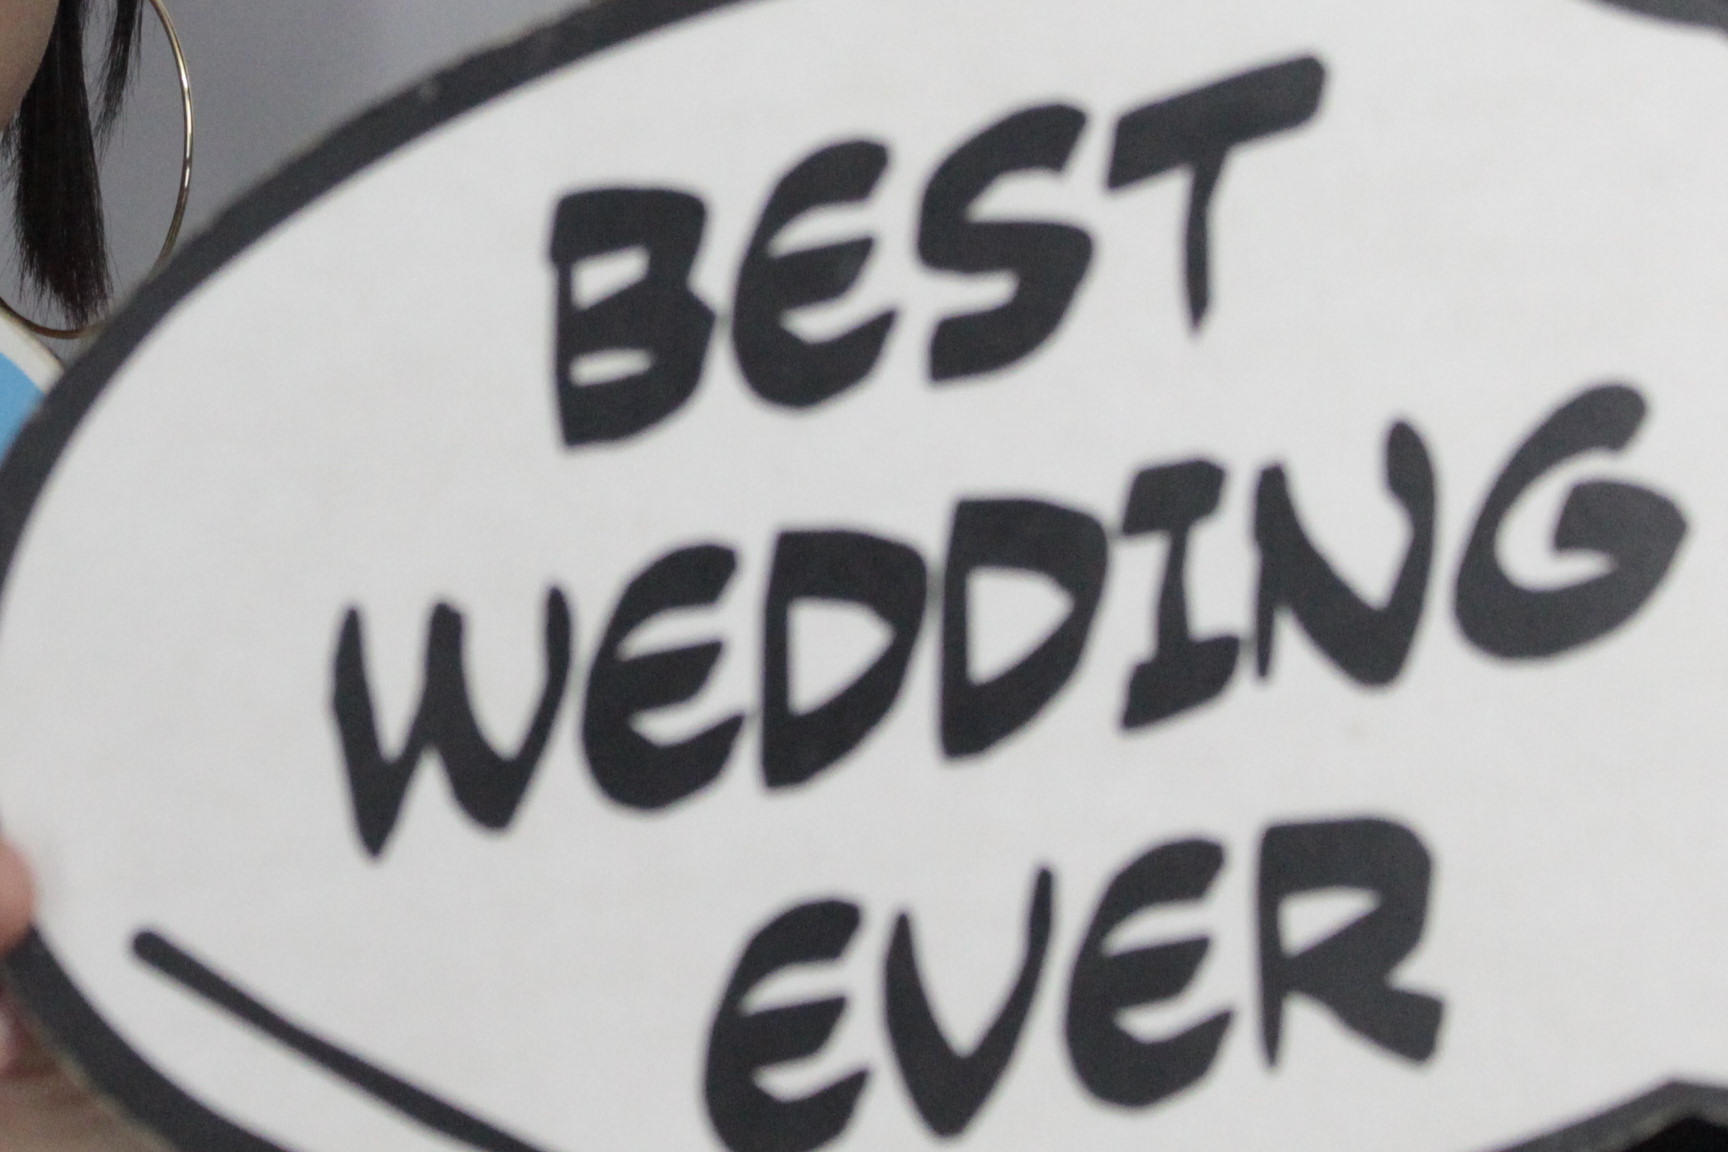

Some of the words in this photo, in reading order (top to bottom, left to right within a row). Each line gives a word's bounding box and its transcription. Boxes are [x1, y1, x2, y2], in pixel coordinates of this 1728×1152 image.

[548, 54, 1328, 450] BEST
[331, 384, 1689, 860] WEDDING
[702, 815, 1446, 1152] EVER
